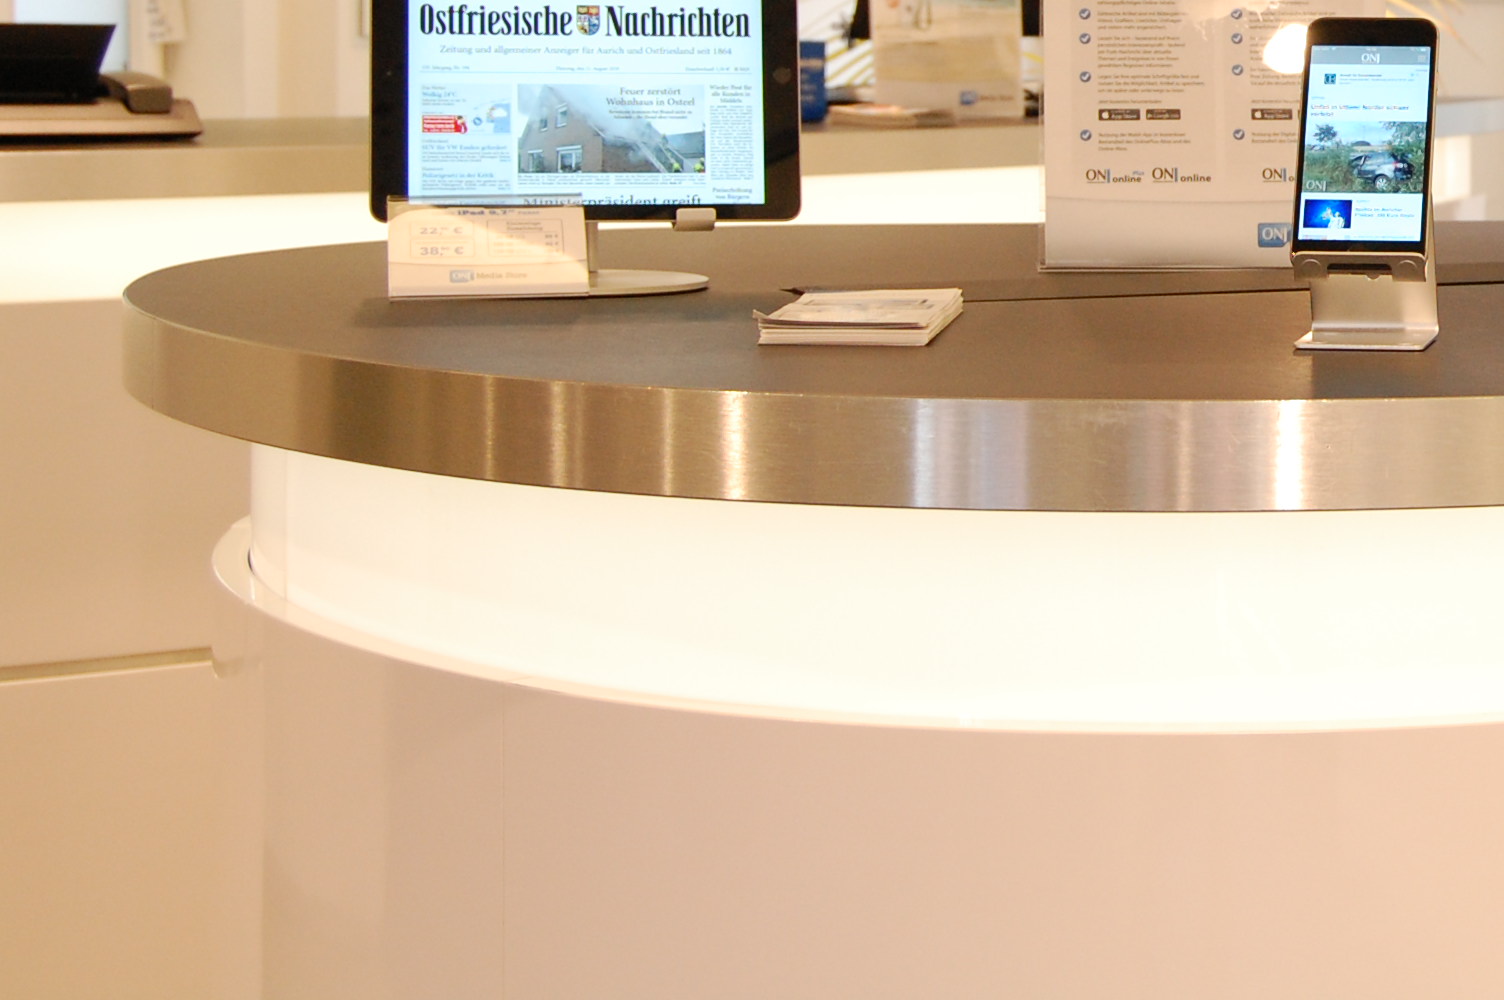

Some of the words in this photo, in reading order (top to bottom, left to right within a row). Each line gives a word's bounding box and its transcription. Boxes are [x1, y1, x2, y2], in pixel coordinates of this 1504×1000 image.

[420, 3, 573, 36] Ostfriesische
[605, 5, 751, 38] Nachrichten
[440, 45, 473, 55] Zeitung
[475, 45, 491, 54] und
[494, 45, 541, 56] allgemeiner
[544, 46, 579, 56] Anzeiger
[582, 46, 595, 55] für
[596, 47, 625, 55] Aurich
[627, 47, 643, 55] und
[645, 46, 695, 56] Ostfriesland
[712, 47, 732, 56] 1864
[619, 87, 644, 96] Feuer
[647, 87, 680, 96] zerstört
[606, 97, 654, 106] Wohnhaus
[656, 98, 665, 106] in
[1181, 174, 1211, 182] online
[476, 271, 503, 279] Media
[506, 271, 528, 279] Store
